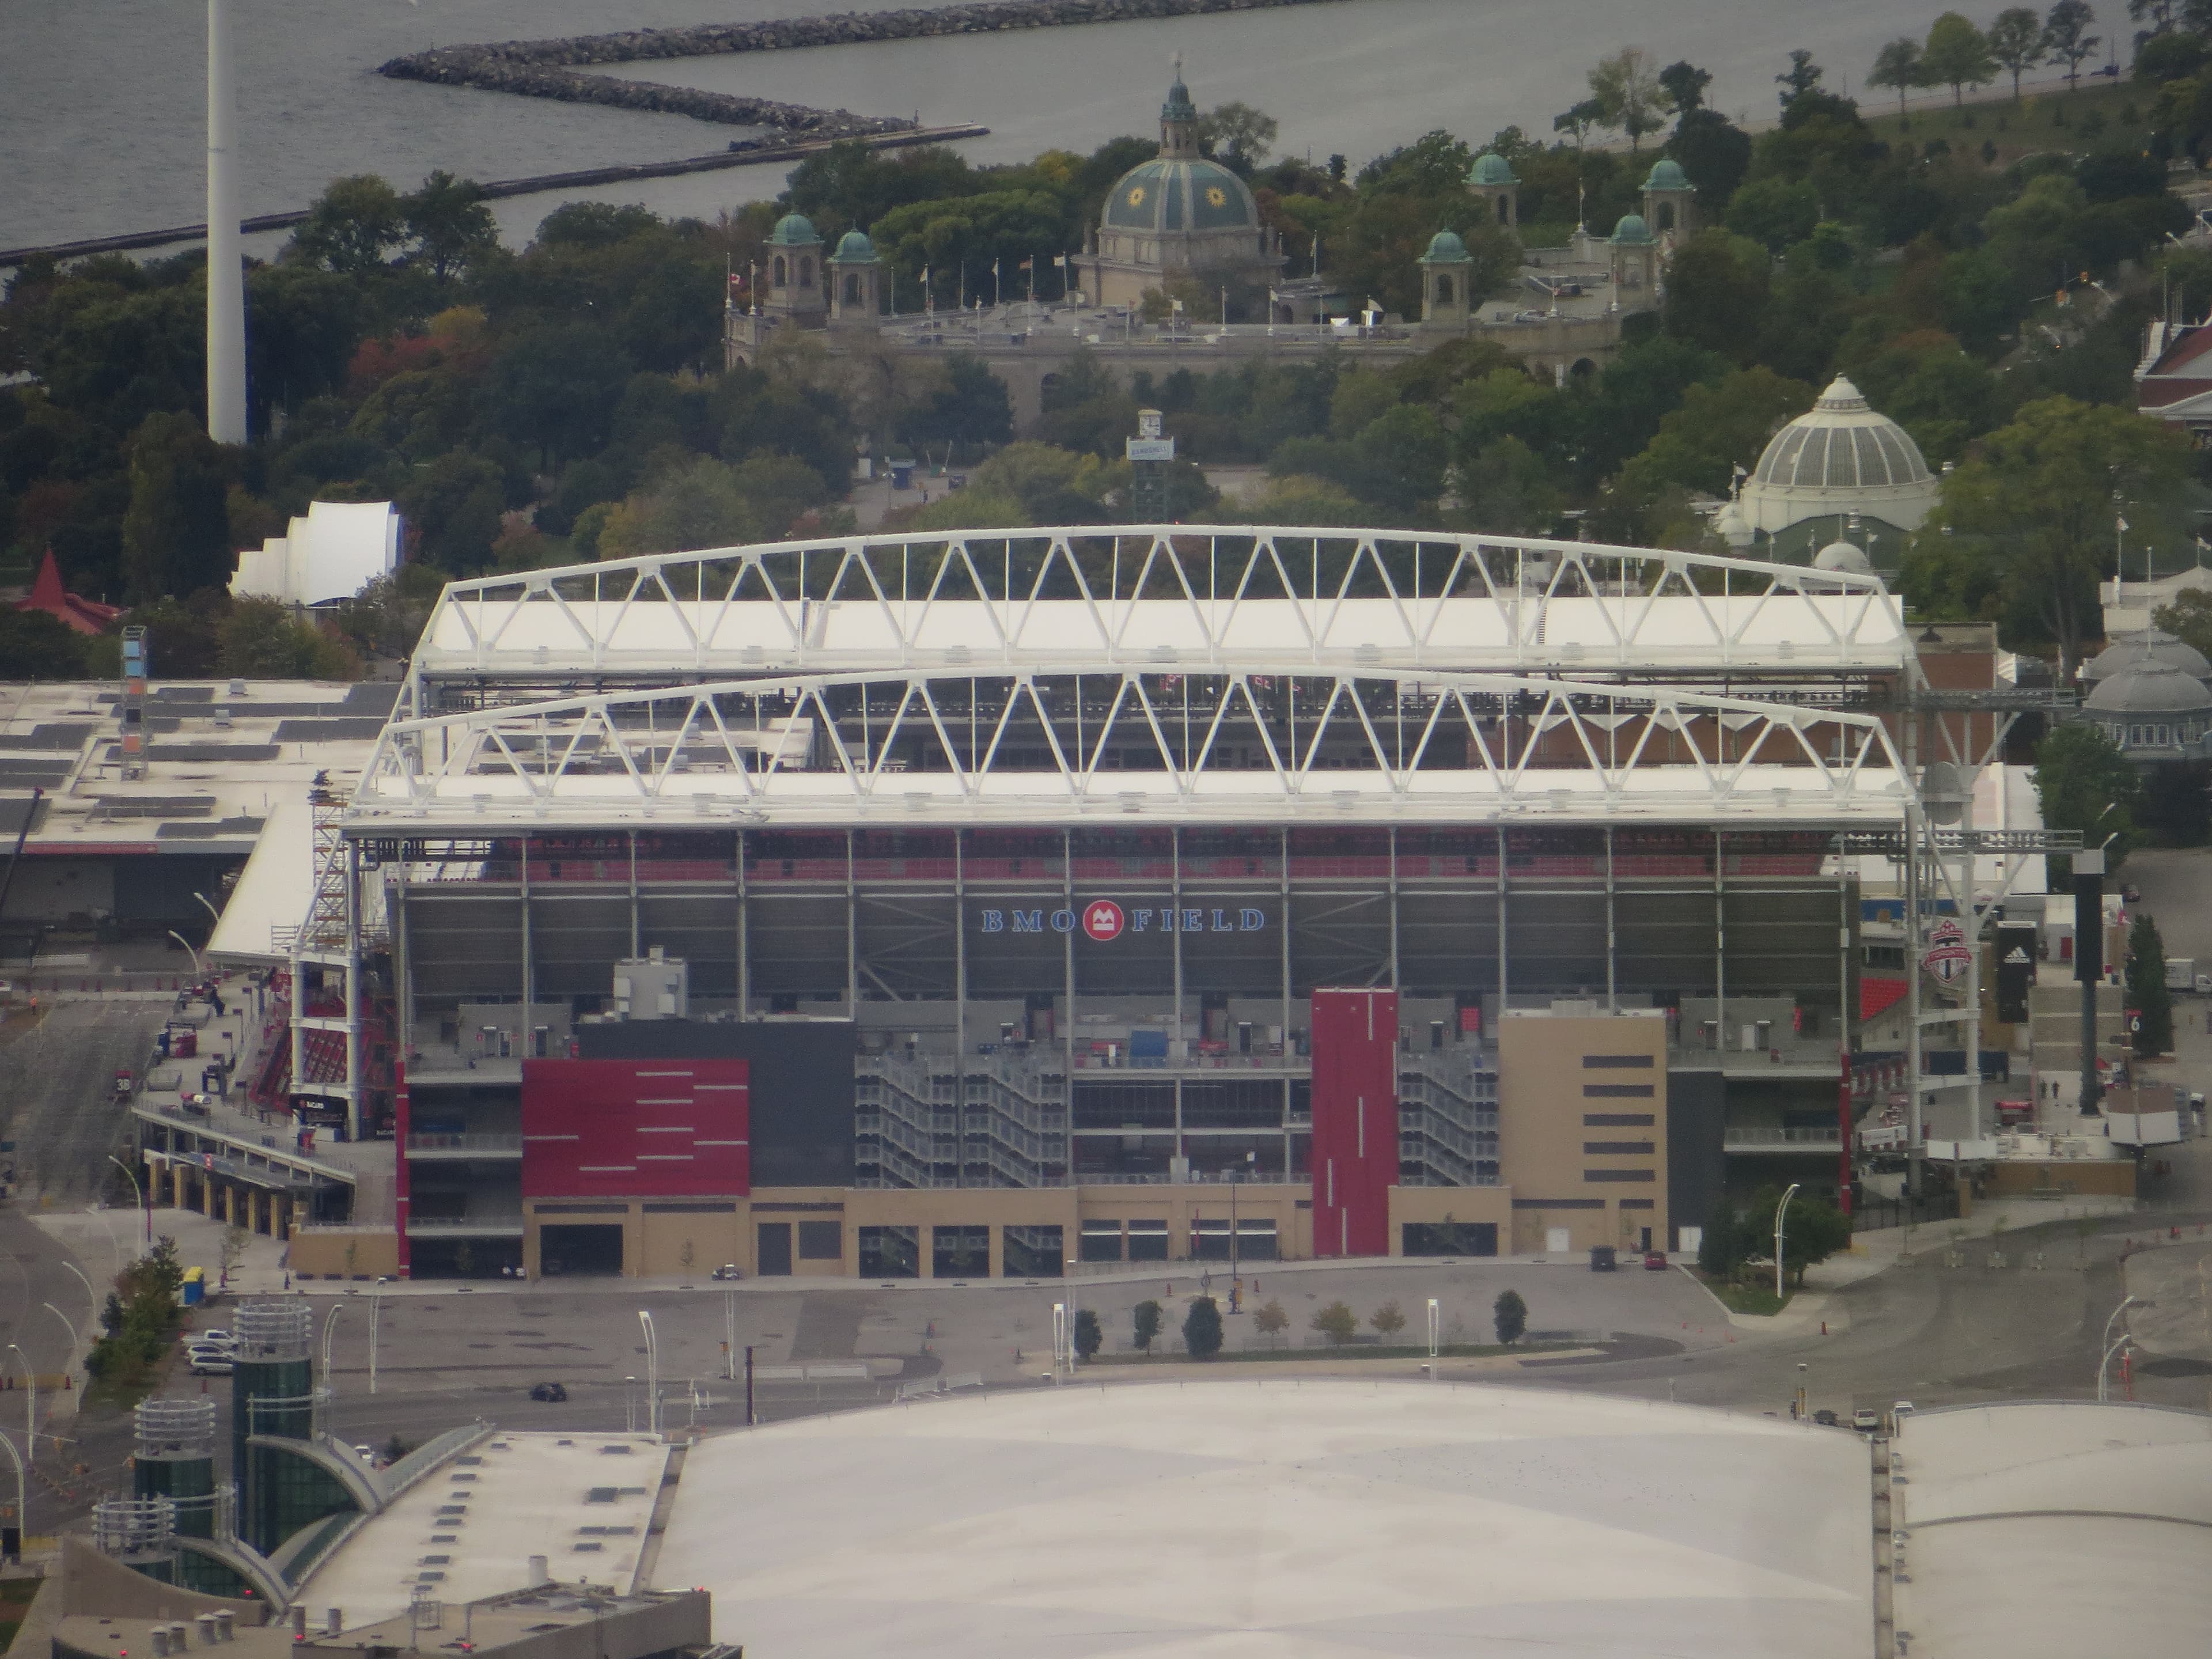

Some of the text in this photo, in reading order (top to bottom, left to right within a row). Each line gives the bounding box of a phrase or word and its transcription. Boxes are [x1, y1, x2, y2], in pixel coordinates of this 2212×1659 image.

[982, 909, 1265, 932] BMO FIELD
[2131, 1016, 2140, 1031] 6
